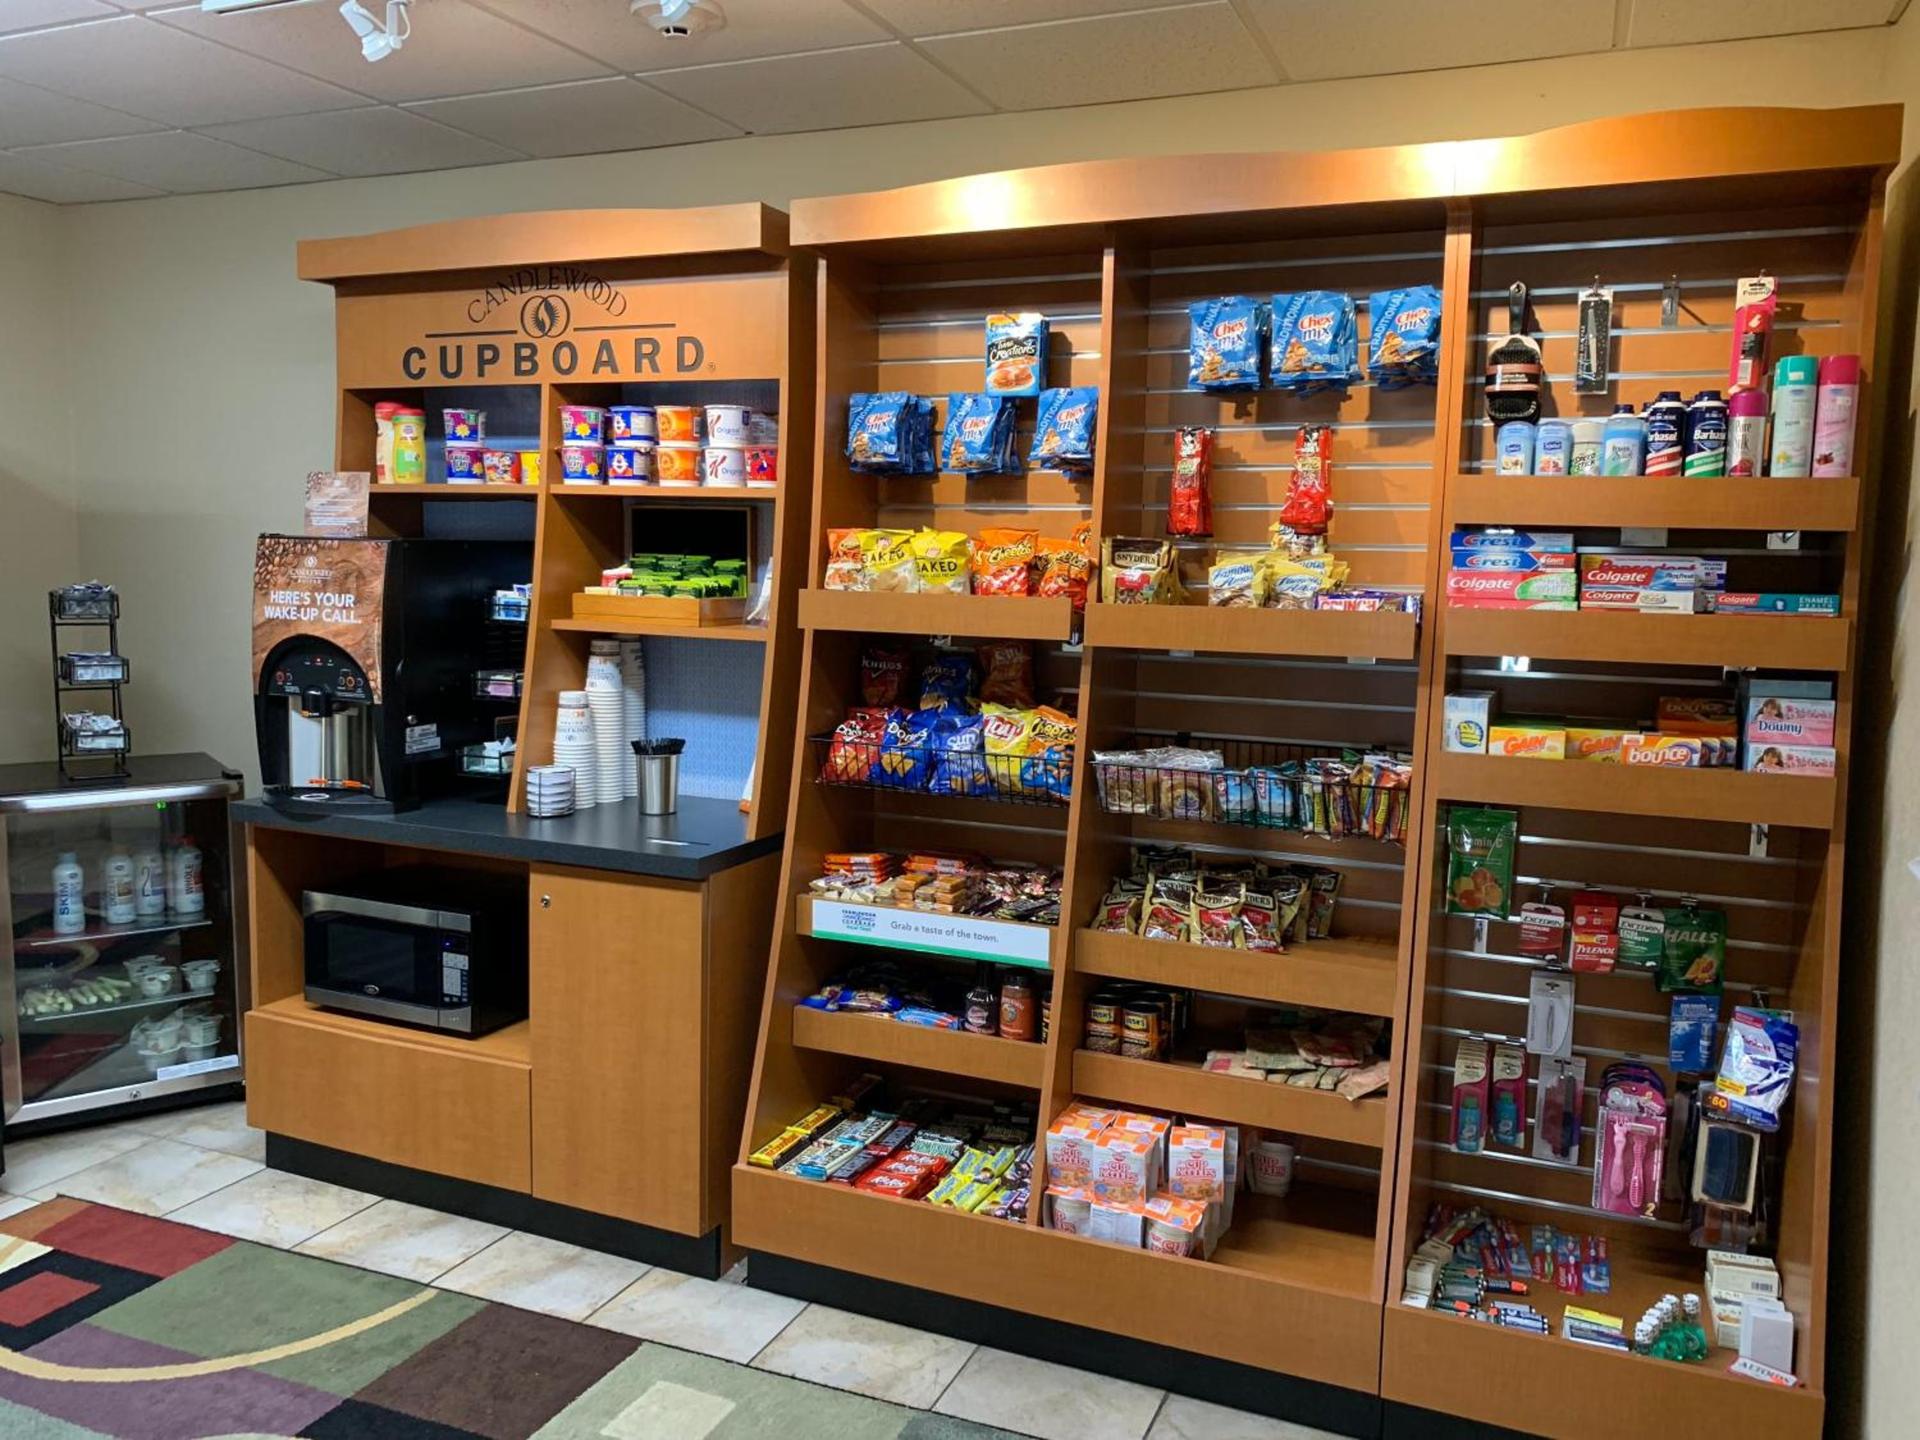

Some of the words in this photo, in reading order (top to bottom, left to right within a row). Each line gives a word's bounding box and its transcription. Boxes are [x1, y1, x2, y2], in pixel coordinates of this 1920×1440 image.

[467, 266, 627, 323] CANDLEWOOD
[1298, 311, 1335, 332] Chex
[1370, 291, 1406, 352] TRADITIONAL
[1395, 306, 1432, 326] Chex
[1213, 318, 1248, 337] Chex
[1398, 317, 1428, 333] mix
[1302, 326, 1330, 342] mix
[402, 336, 705, 380] CUPBOARD
[990, 344, 1036, 362] Creations
[1056, 403, 1088, 422] Chex
[962, 416, 989, 430] Chex
[1463, 534, 1521, 546] Crest
[1466, 555, 1521, 567] Crest
[1450, 576, 1513, 591] Colgate
[1587, 570, 1647, 583] Colgate
[270, 590, 311, 606] HERE'S
[314, 592, 355, 607] YOUR
[1585, 591, 1635, 602] Colgate
[1717, 595, 1757, 605] Colgate
[264, 606, 319, 621] WAKE-UP
[322, 609, 362, 624] CALL.
[836, 724, 878, 740] Doritos
[1758, 719, 1803, 735] Downy
[1629, 747, 1688, 764] bounce
[185, 863, 195, 895] WHOLE
[58, 882, 70, 916] SKIM
[1522, 915, 1563, 928] EXCEDRIN
[1620, 920, 1663, 933] EXCEDRIN
[890, 920, 912, 933] Grab
[921, 924, 942, 936] taste
[945, 926, 955, 938] of
[956, 928, 971, 940] the
[973, 930, 999, 943] town.
[1664, 929, 1720, 943] HALLS
[1575, 943, 1616, 955] TYLENOL
[1712, 1095, 1727, 1109] 60
[1101, 1168, 1138, 1182] NOODLES
[1176, 1166, 1217, 1177] NOODLES
[1646, 1202, 1656, 1216] 2
